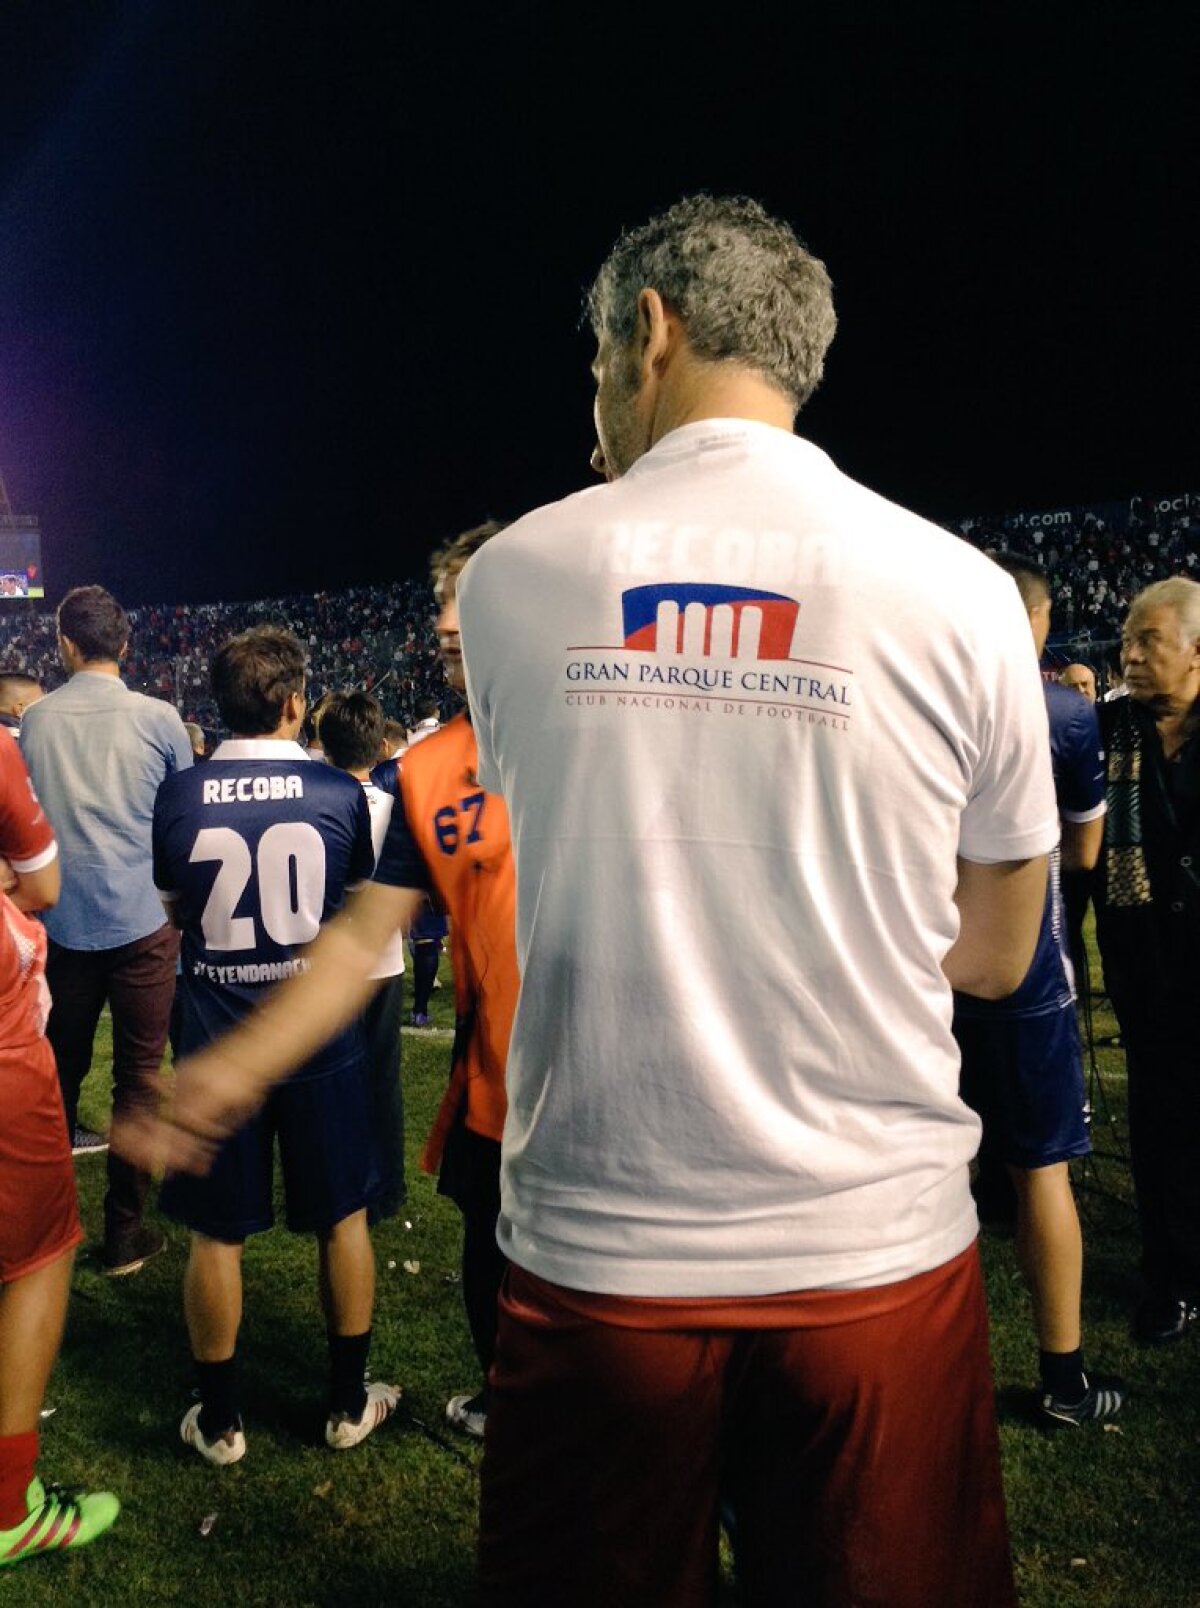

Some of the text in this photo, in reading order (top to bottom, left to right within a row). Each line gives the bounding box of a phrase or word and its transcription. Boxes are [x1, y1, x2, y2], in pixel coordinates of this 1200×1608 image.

[566, 662, 851, 706] GRAN PARQUE CENTRAL
[566, 695, 849, 731] CLUB NACIONAL DE FOOTBALL
[203, 776, 303, 805] RECOBA
[434, 791, 485, 855] 67
[189, 822, 326, 951] 20
